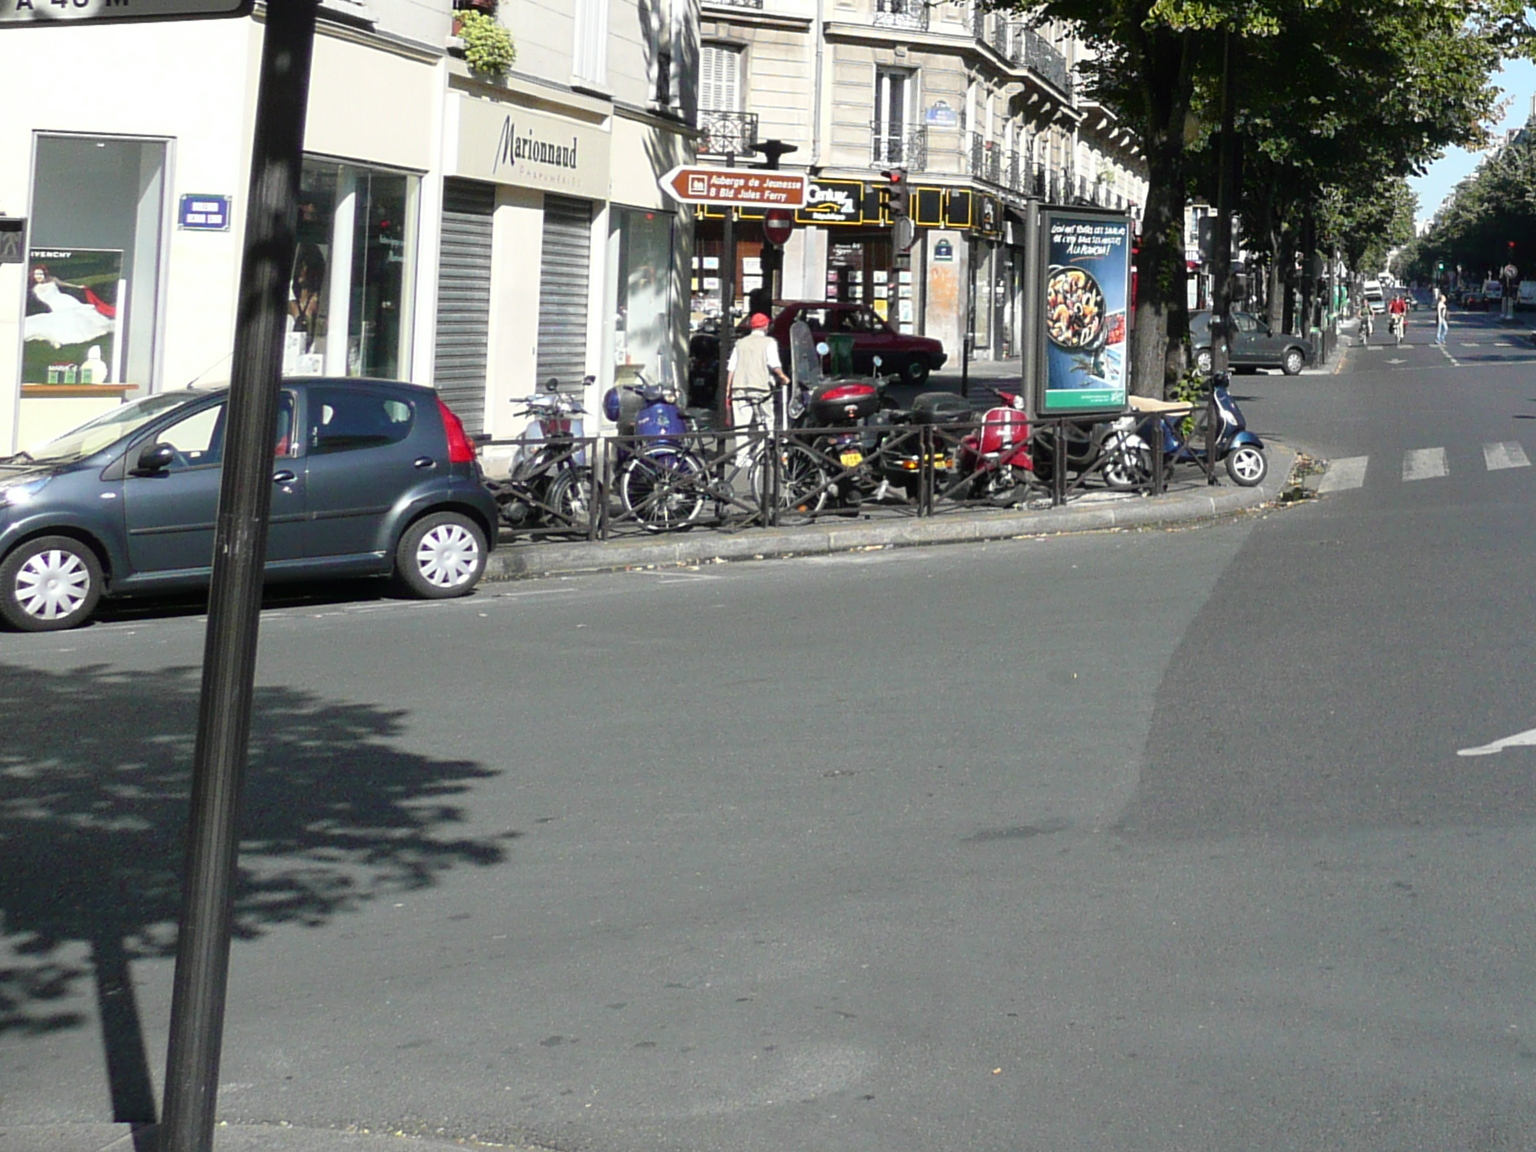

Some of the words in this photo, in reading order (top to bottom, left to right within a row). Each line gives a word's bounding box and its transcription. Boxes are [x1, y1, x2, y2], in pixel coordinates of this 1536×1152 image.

[493, 114, 577, 175] Marionnaud
[711, 175, 744, 189] Auberge
[748, 178, 759, 187] de
[763, 178, 801, 189] Jeunesse
[738, 189, 760, 200] Jules
[764, 190, 787, 202] Ferry
[806, 184, 848, 204] Century
